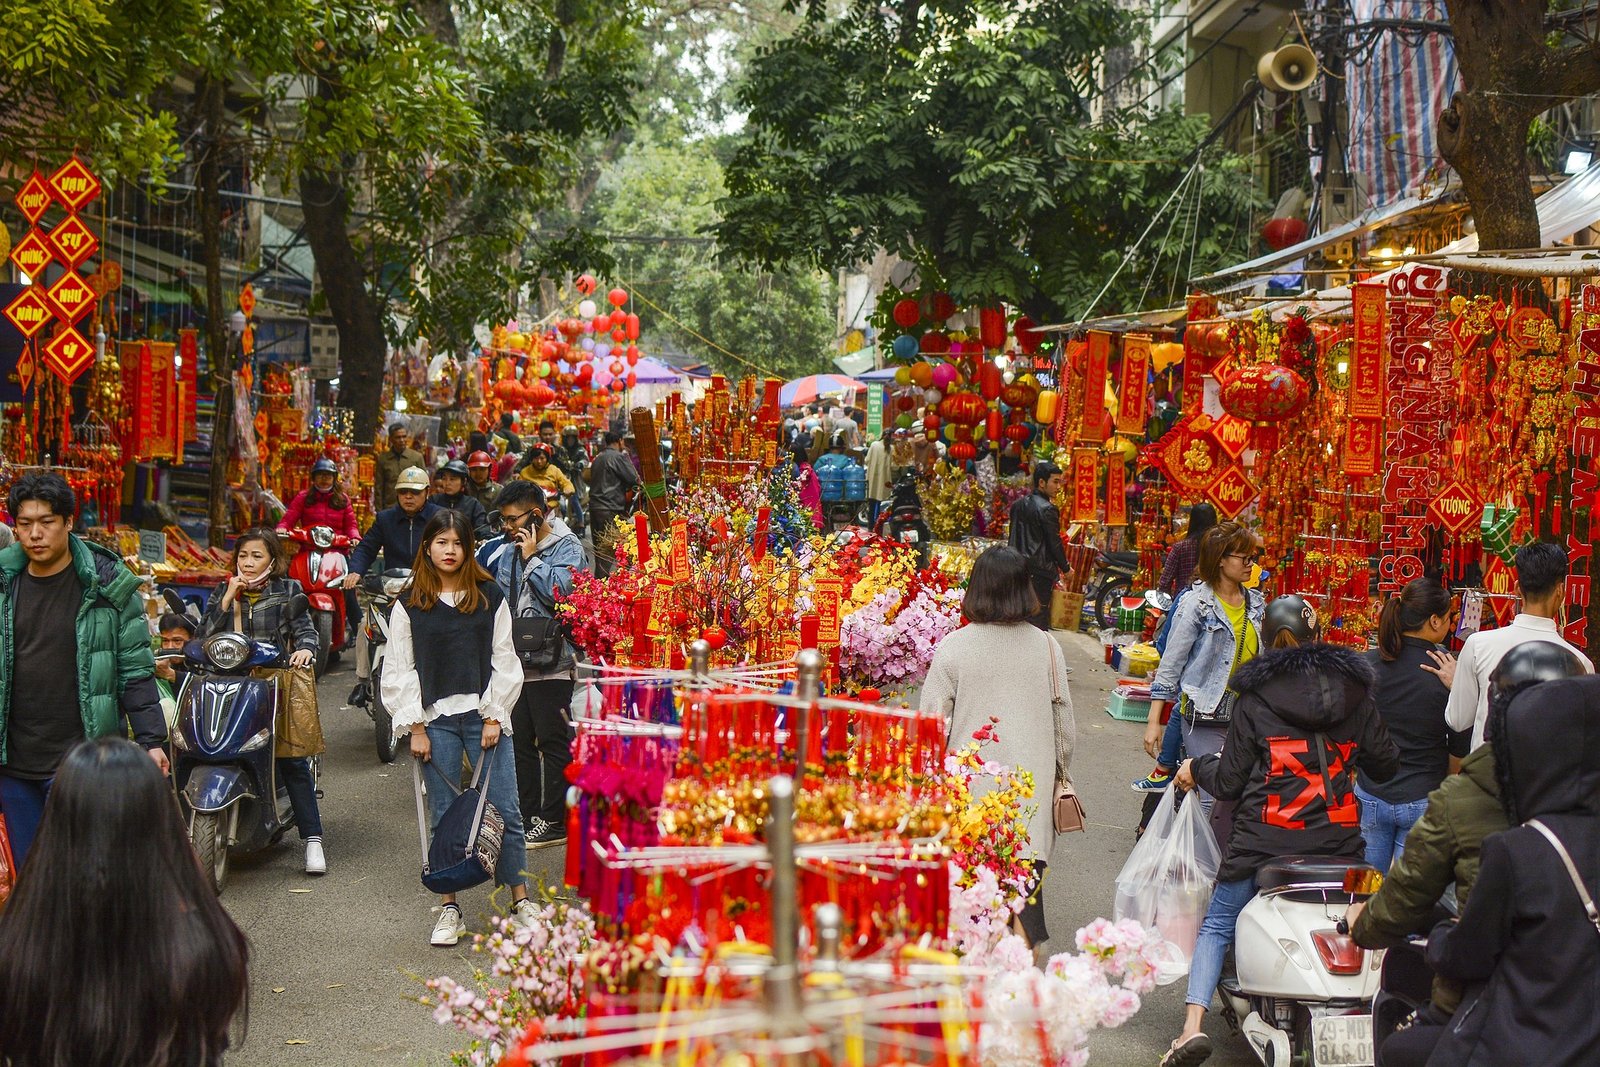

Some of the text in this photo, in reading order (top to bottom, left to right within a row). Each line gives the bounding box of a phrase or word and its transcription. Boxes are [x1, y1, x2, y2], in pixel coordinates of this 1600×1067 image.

[1217, 476, 1246, 503] NĂM
[1440, 495, 1471, 517] VƯỢNG
[1492, 567, 1510, 594] MỚI
